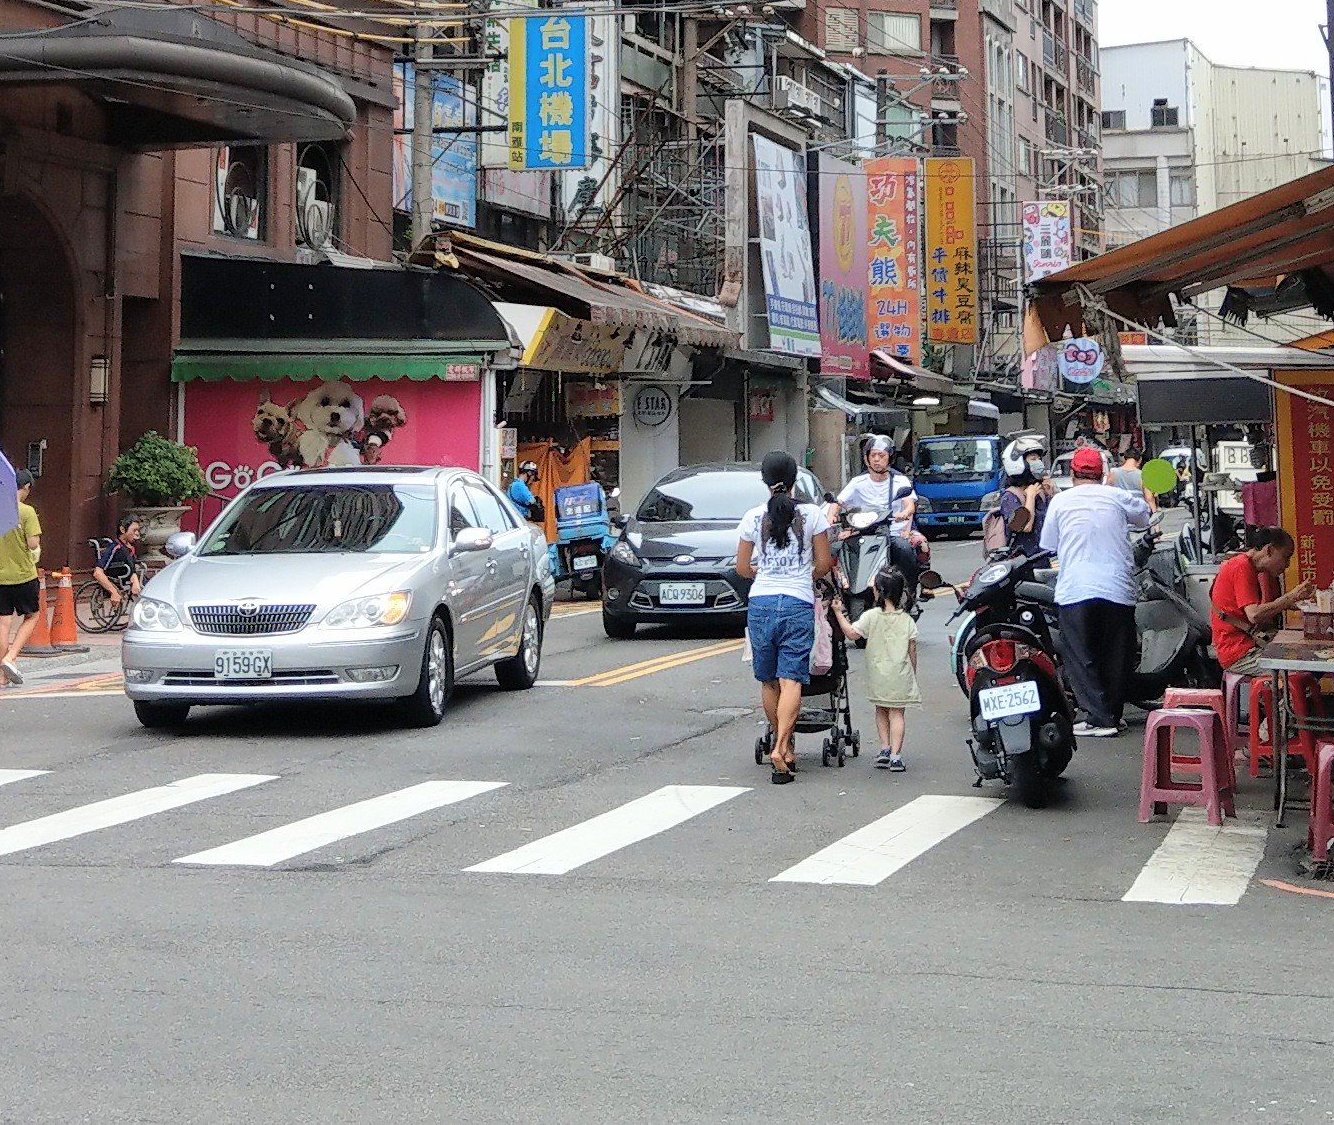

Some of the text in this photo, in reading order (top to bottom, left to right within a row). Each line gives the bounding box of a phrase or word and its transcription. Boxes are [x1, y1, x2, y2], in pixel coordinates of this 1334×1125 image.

[539, 16, 573, 165] 台北機場
[953, 246, 976, 325] 麻辣臭豆腐
[876, 300, 909, 316] 24H
[215, 656, 270, 674] 9159-GX
[983, 689, 1037, 713] MXE-2562
